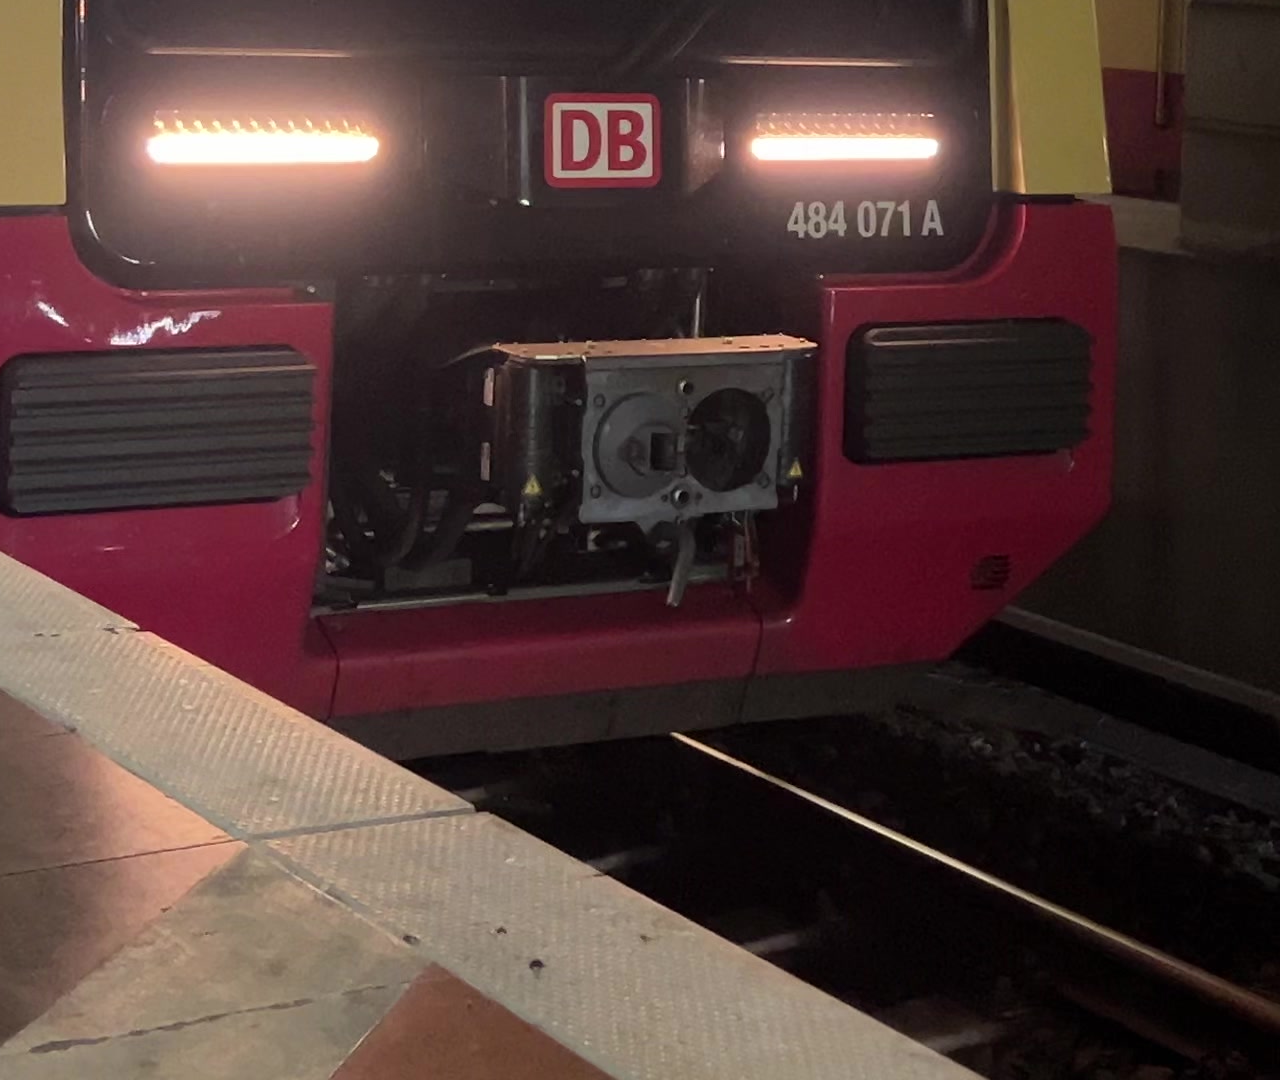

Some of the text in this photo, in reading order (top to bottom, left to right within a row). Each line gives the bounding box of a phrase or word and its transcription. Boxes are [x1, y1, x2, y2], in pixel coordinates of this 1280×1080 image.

[561, 110, 647, 171] DB
[787, 200, 944, 238] 484 071 A
